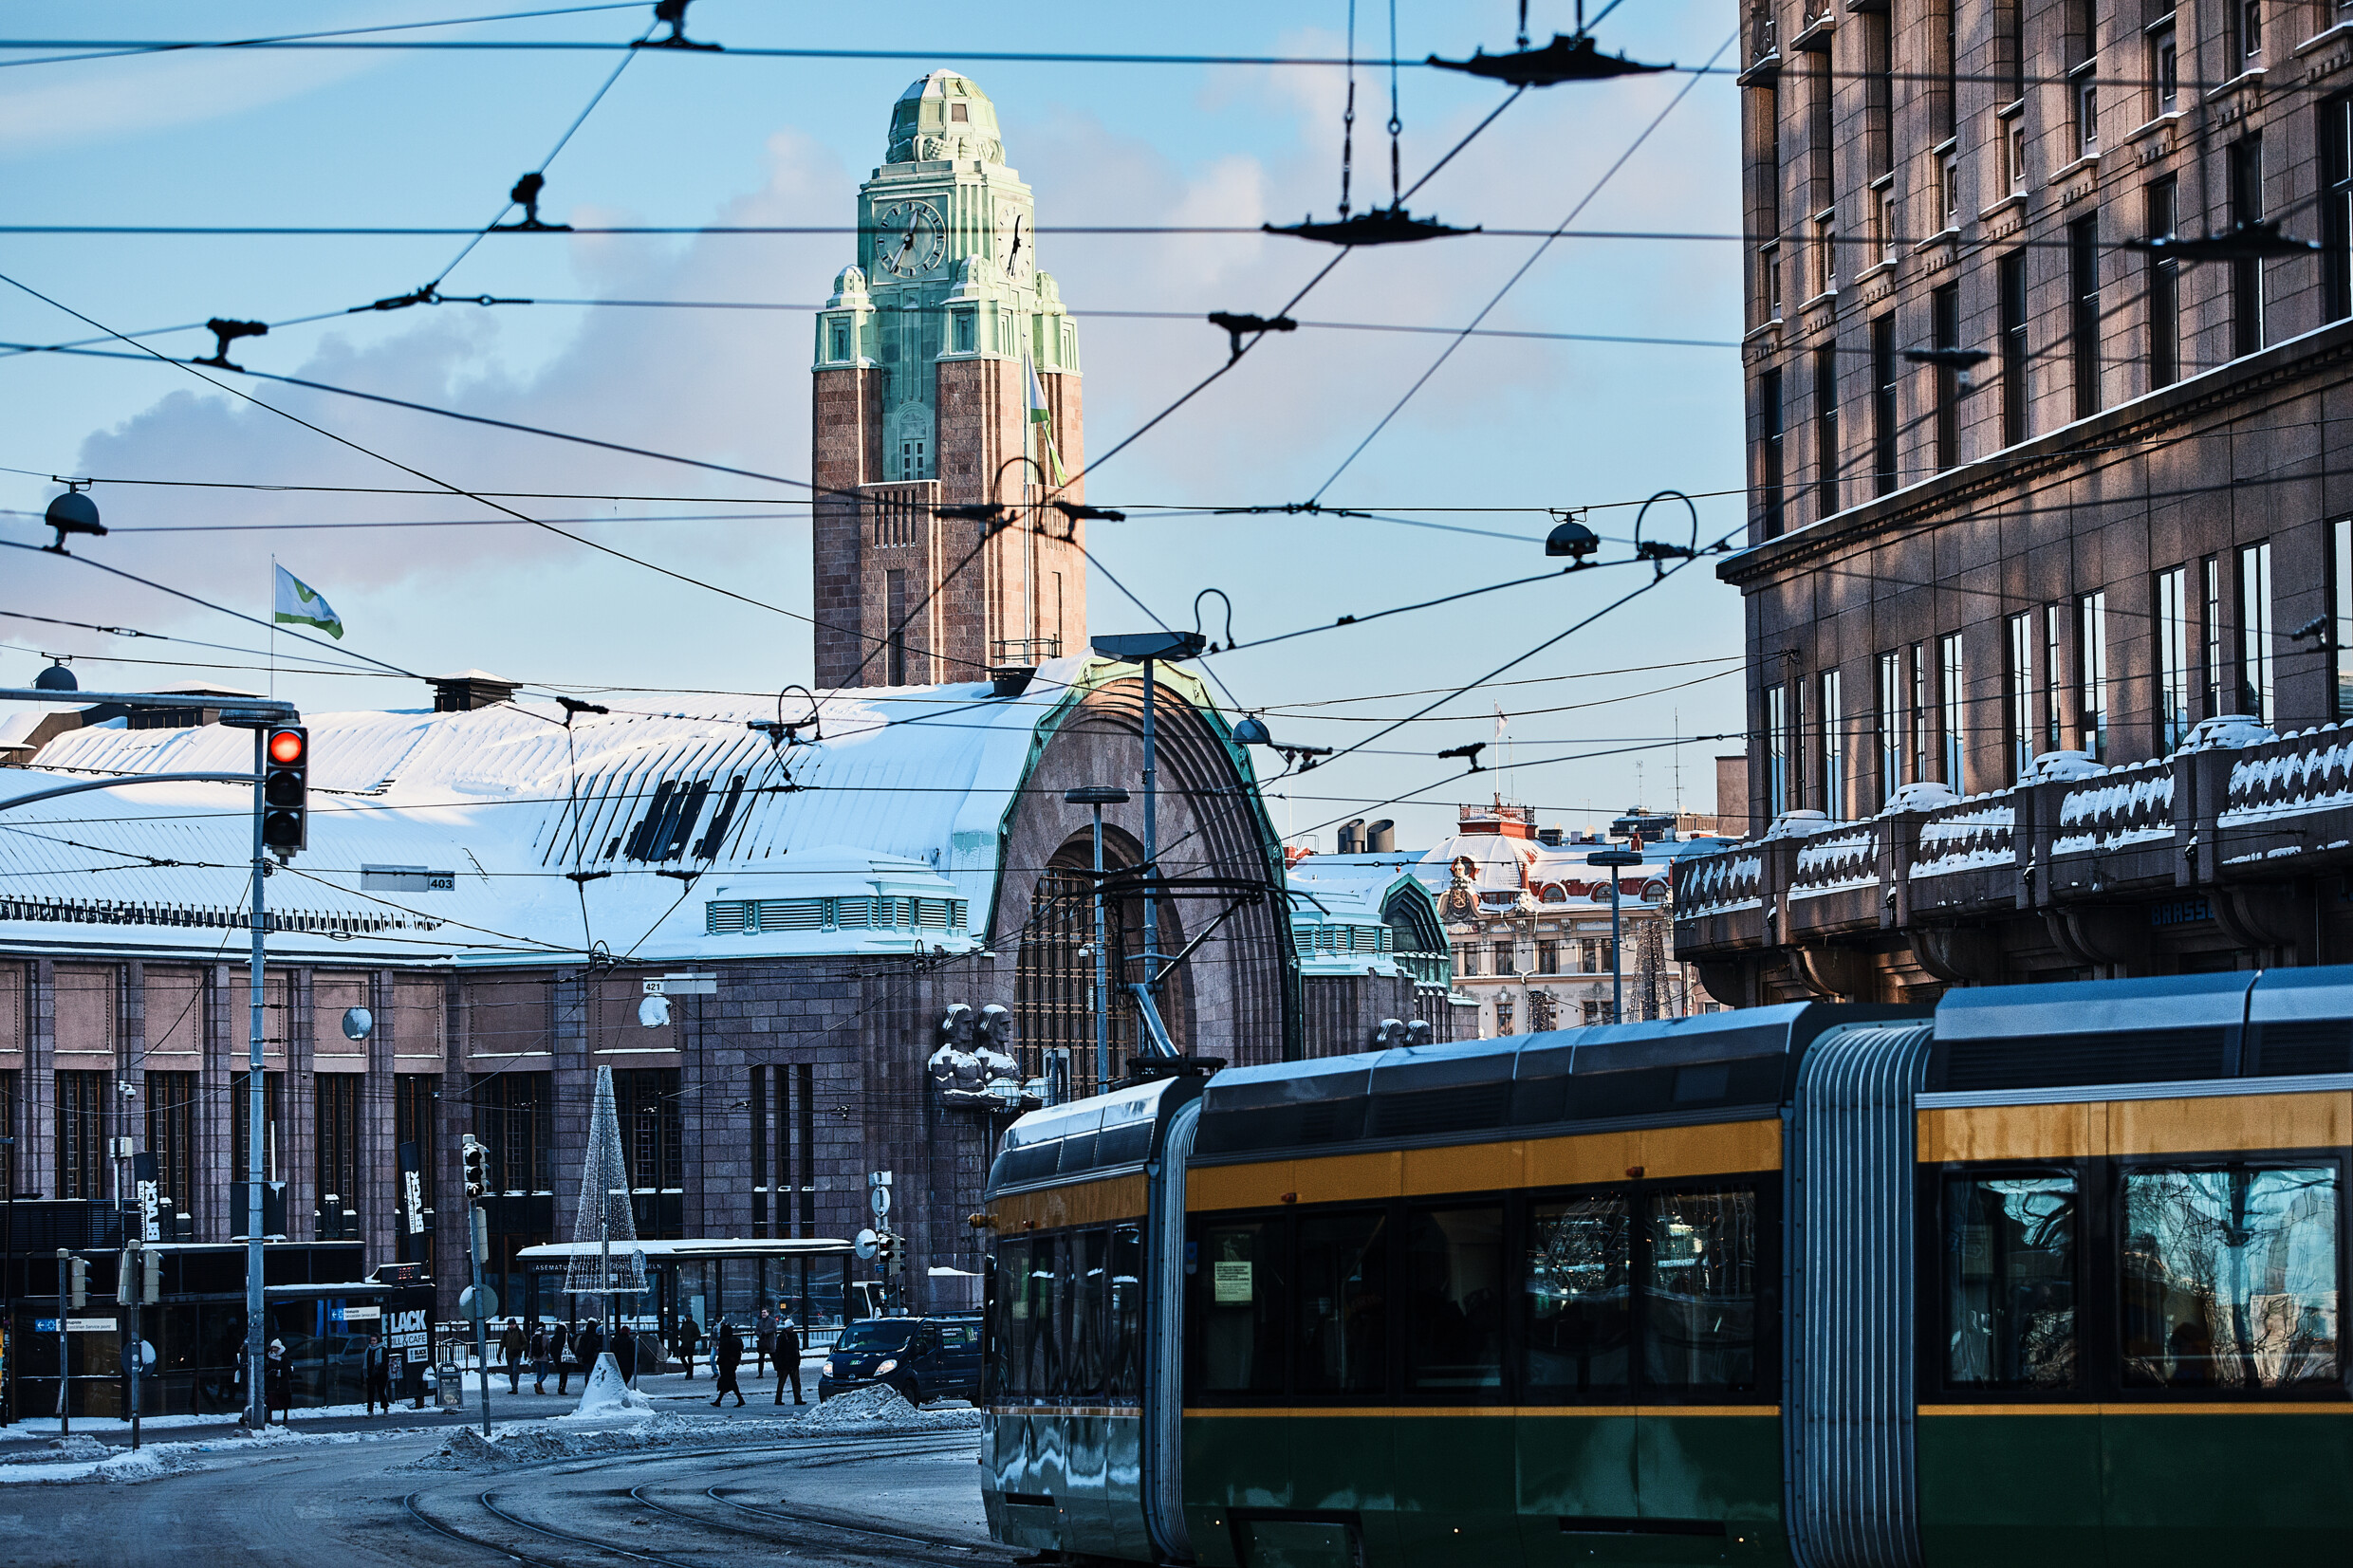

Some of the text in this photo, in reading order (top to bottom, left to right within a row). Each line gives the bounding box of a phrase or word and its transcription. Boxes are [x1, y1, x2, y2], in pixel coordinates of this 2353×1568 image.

[430, 878, 454, 889] 403
[645, 983, 660, 991] 421
[144, 1179, 160, 1242] BLACK
[408, 1335, 426, 1344] CAFE
